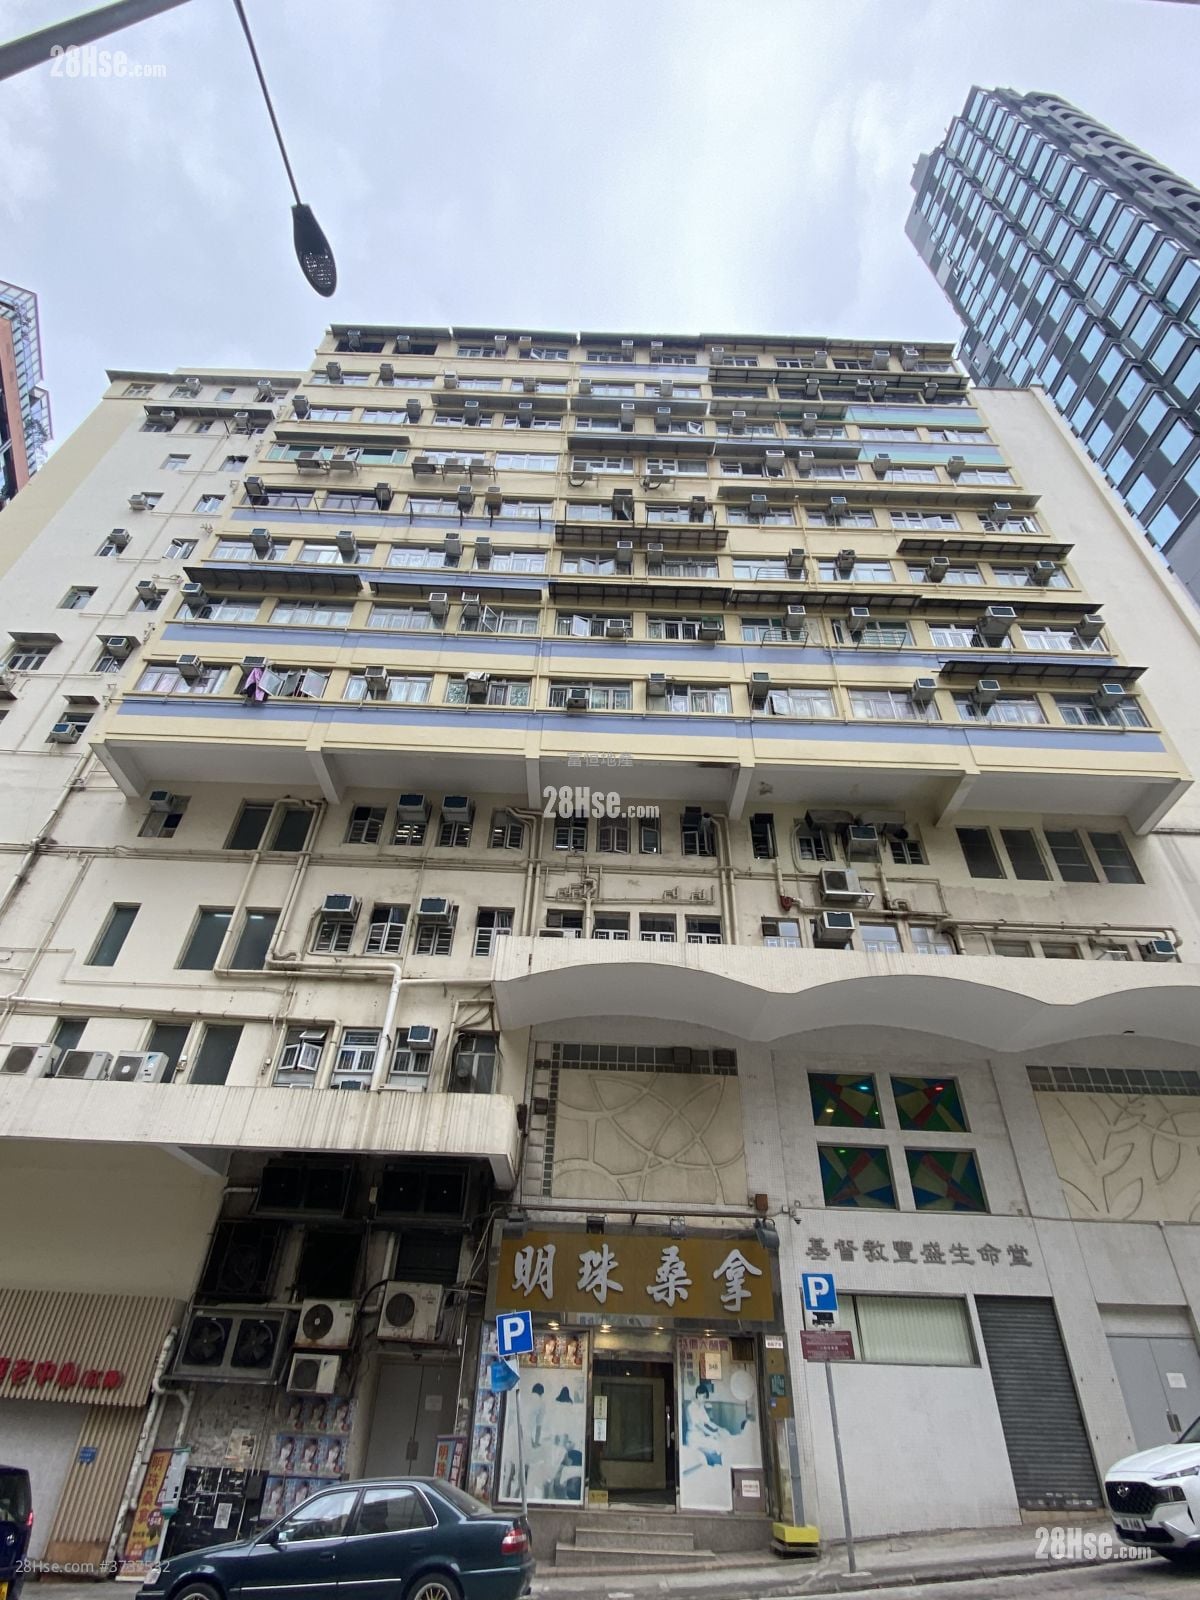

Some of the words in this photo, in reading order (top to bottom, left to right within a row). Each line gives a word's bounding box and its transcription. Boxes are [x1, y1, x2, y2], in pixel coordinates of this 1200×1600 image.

[512, 1243, 762, 1312] 明珠桑拿
[807, 1276, 829, 1307] P
[503, 1317, 525, 1351] P
